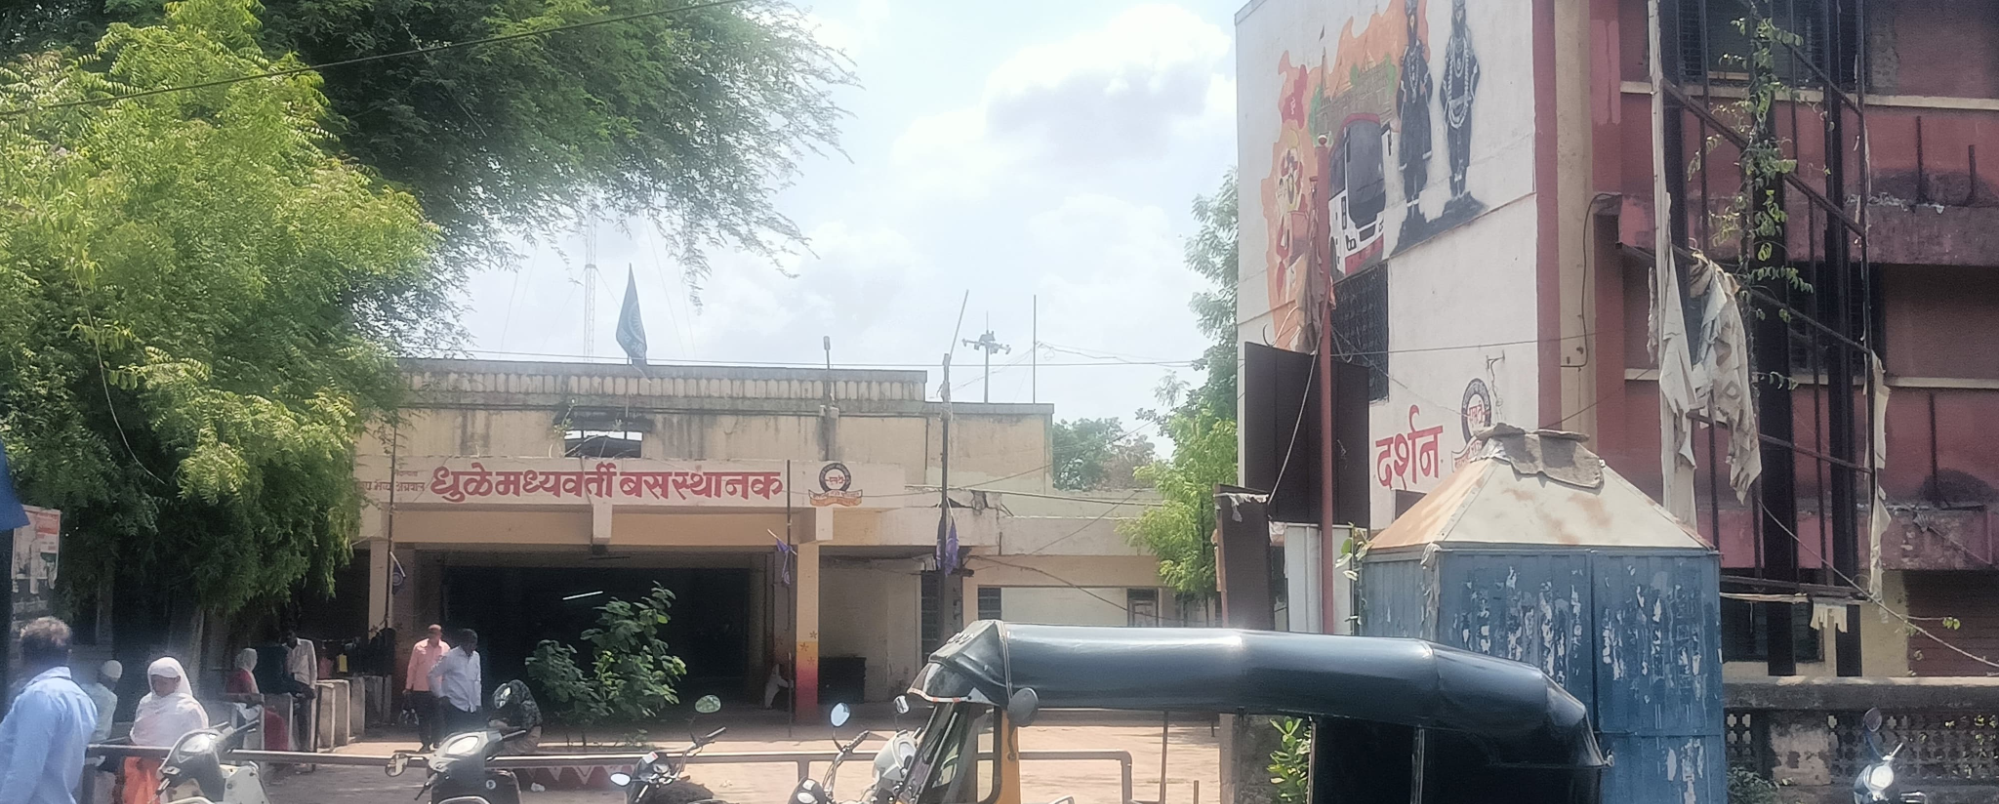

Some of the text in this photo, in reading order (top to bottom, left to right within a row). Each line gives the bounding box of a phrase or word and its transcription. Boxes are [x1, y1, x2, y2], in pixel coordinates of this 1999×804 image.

[1375, 404, 1444, 489] दर्शन
[430, 462, 493, 503] धुळे
[495, 462, 617, 498] मध्यवर्ती
